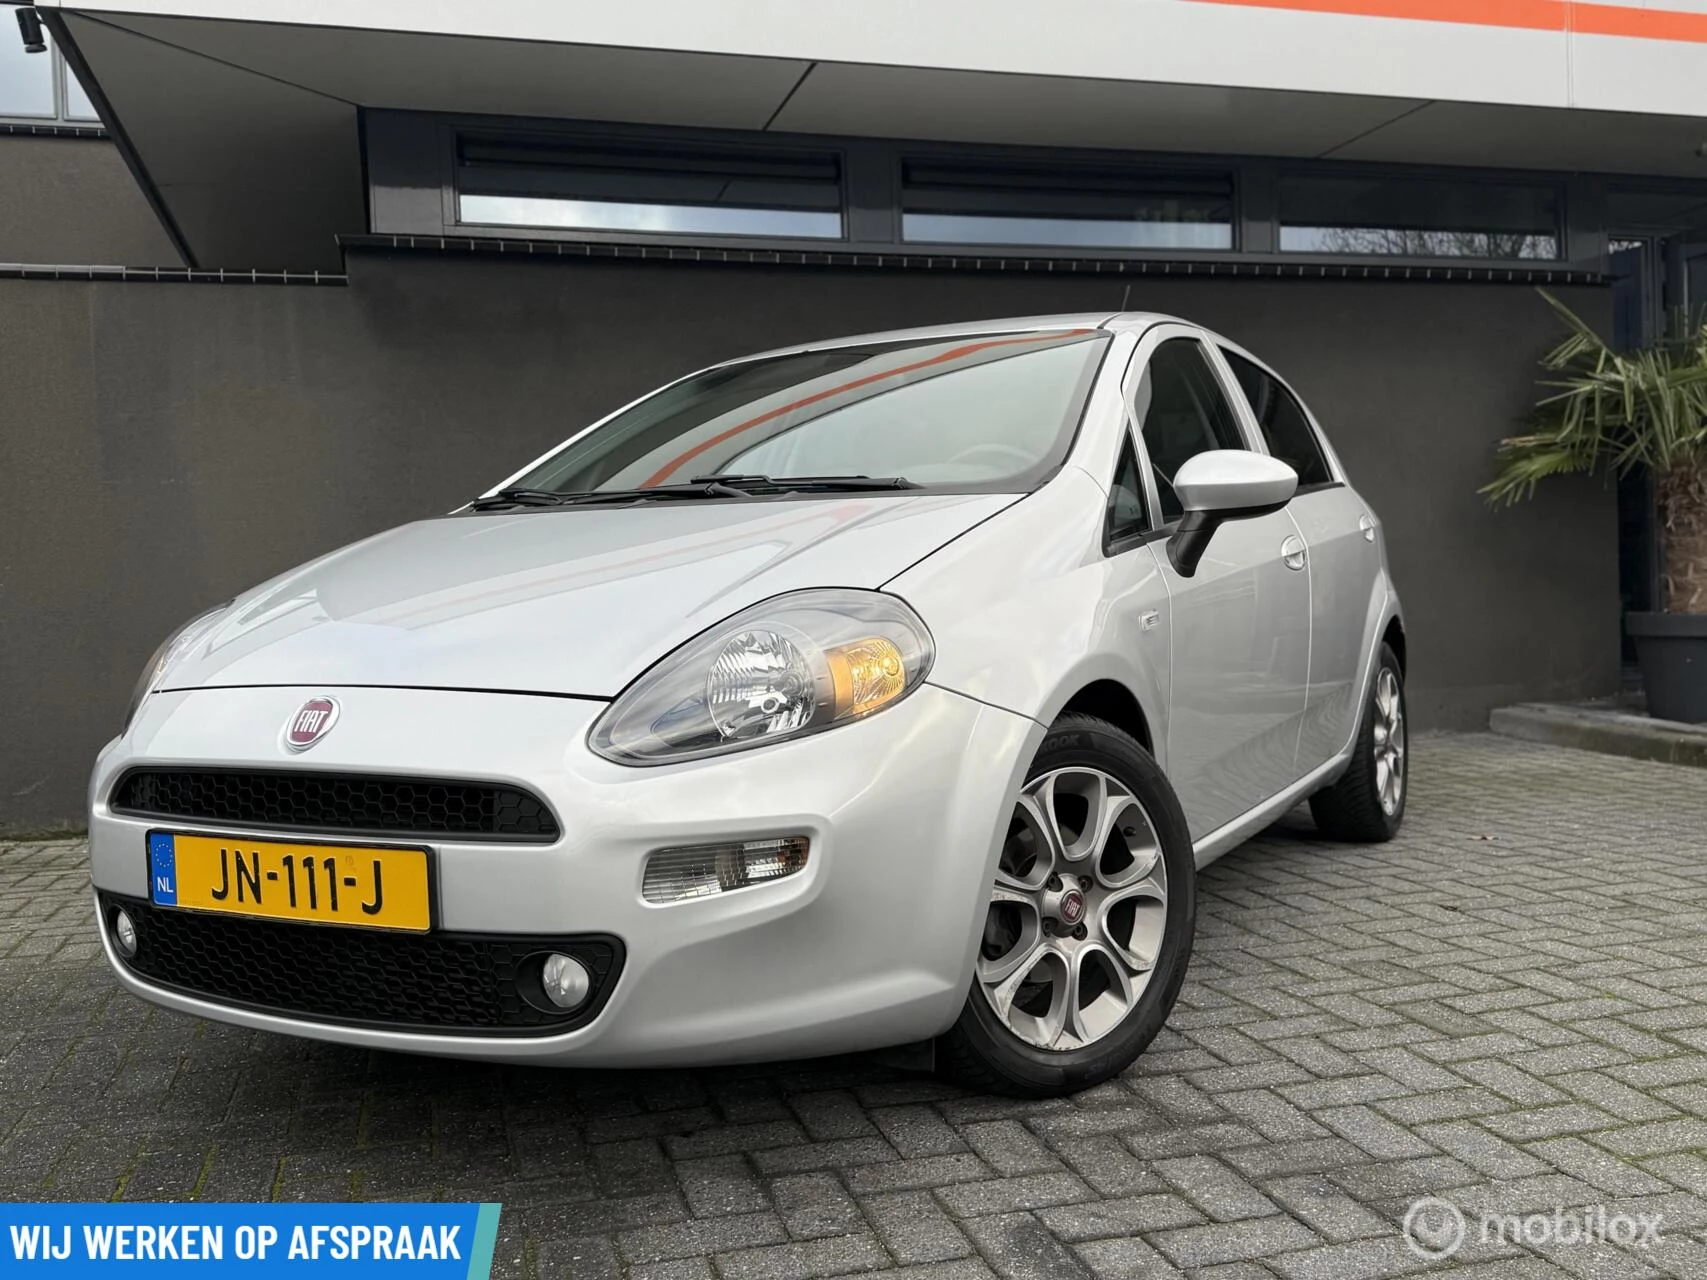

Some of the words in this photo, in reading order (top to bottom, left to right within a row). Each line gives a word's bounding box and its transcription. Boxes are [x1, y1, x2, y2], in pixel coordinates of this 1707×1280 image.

[294, 710, 329, 733] FIAT
[157, 876, 174, 893] NL
[211, 848, 383, 915] JN-111-J
[1065, 898, 1080, 917] FIAT
